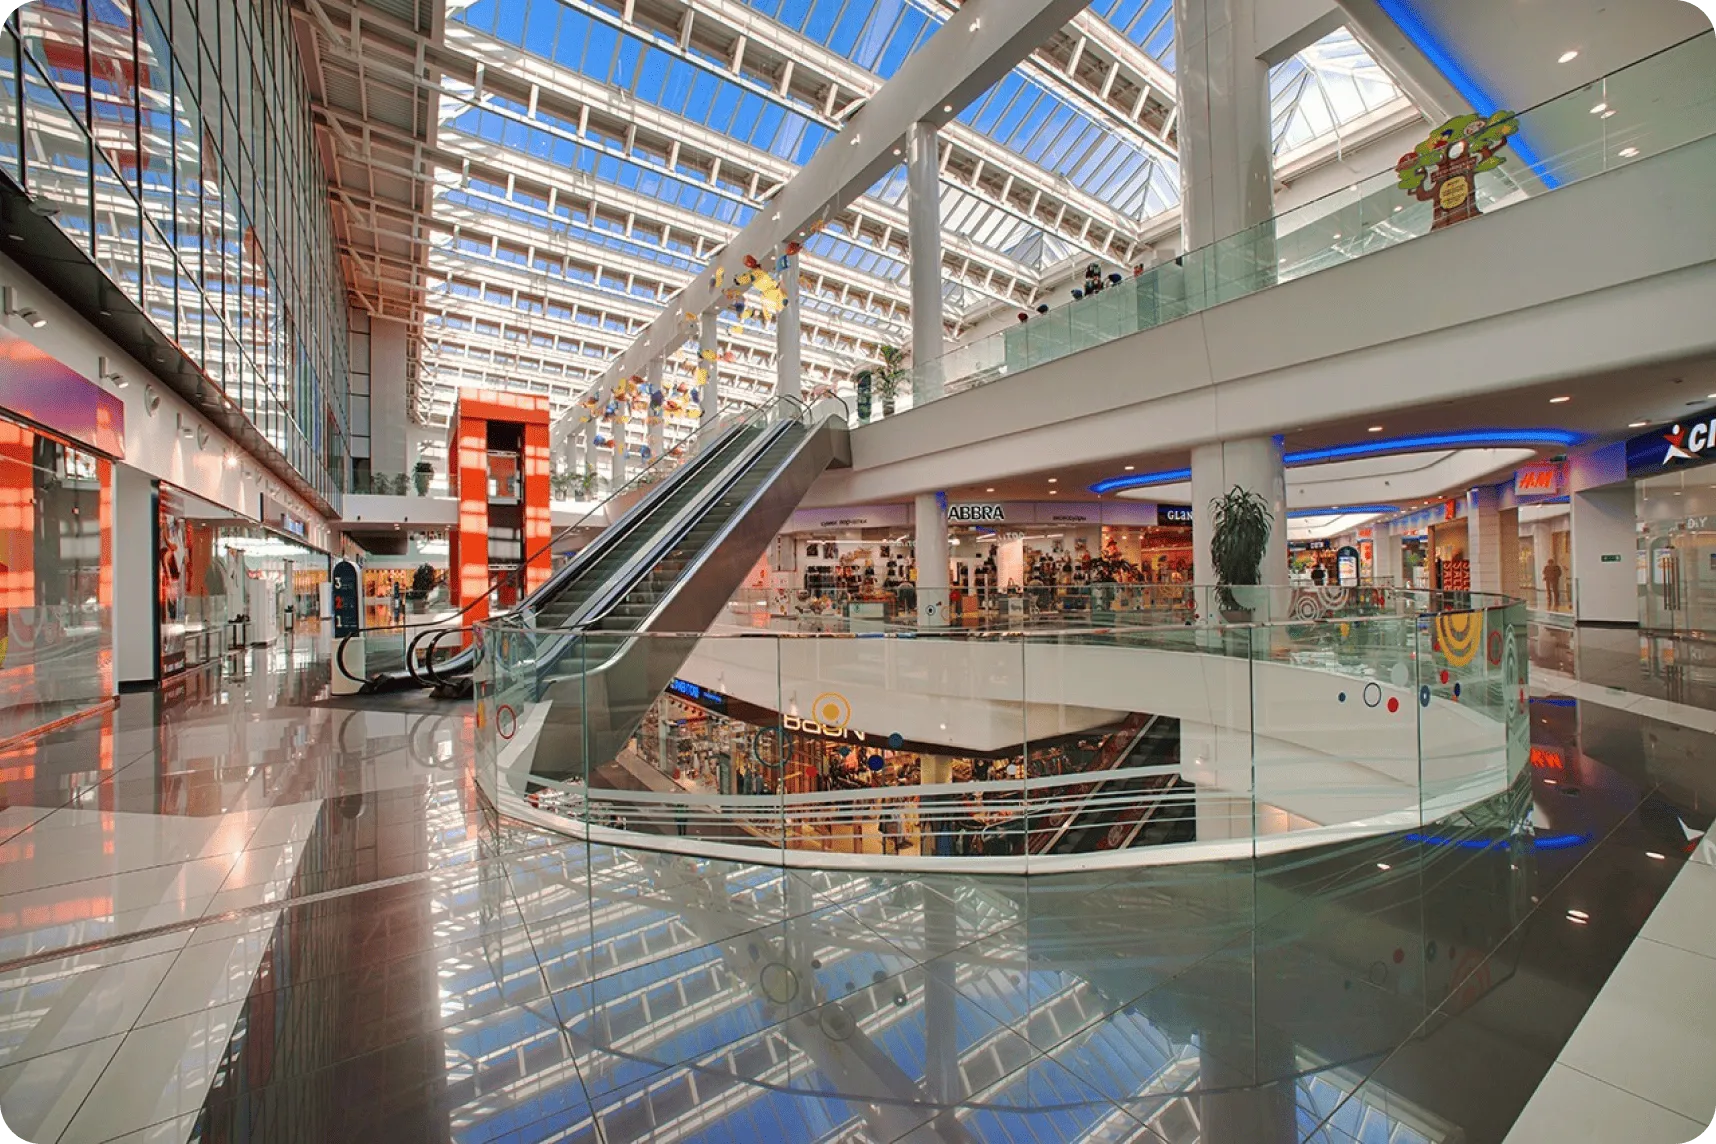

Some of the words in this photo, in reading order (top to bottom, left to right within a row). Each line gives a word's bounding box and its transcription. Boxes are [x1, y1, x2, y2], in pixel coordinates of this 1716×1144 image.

[948, 505, 1005, 521] ABBRA
[335, 577, 341, 589] 3
[336, 616, 342, 628] 1
